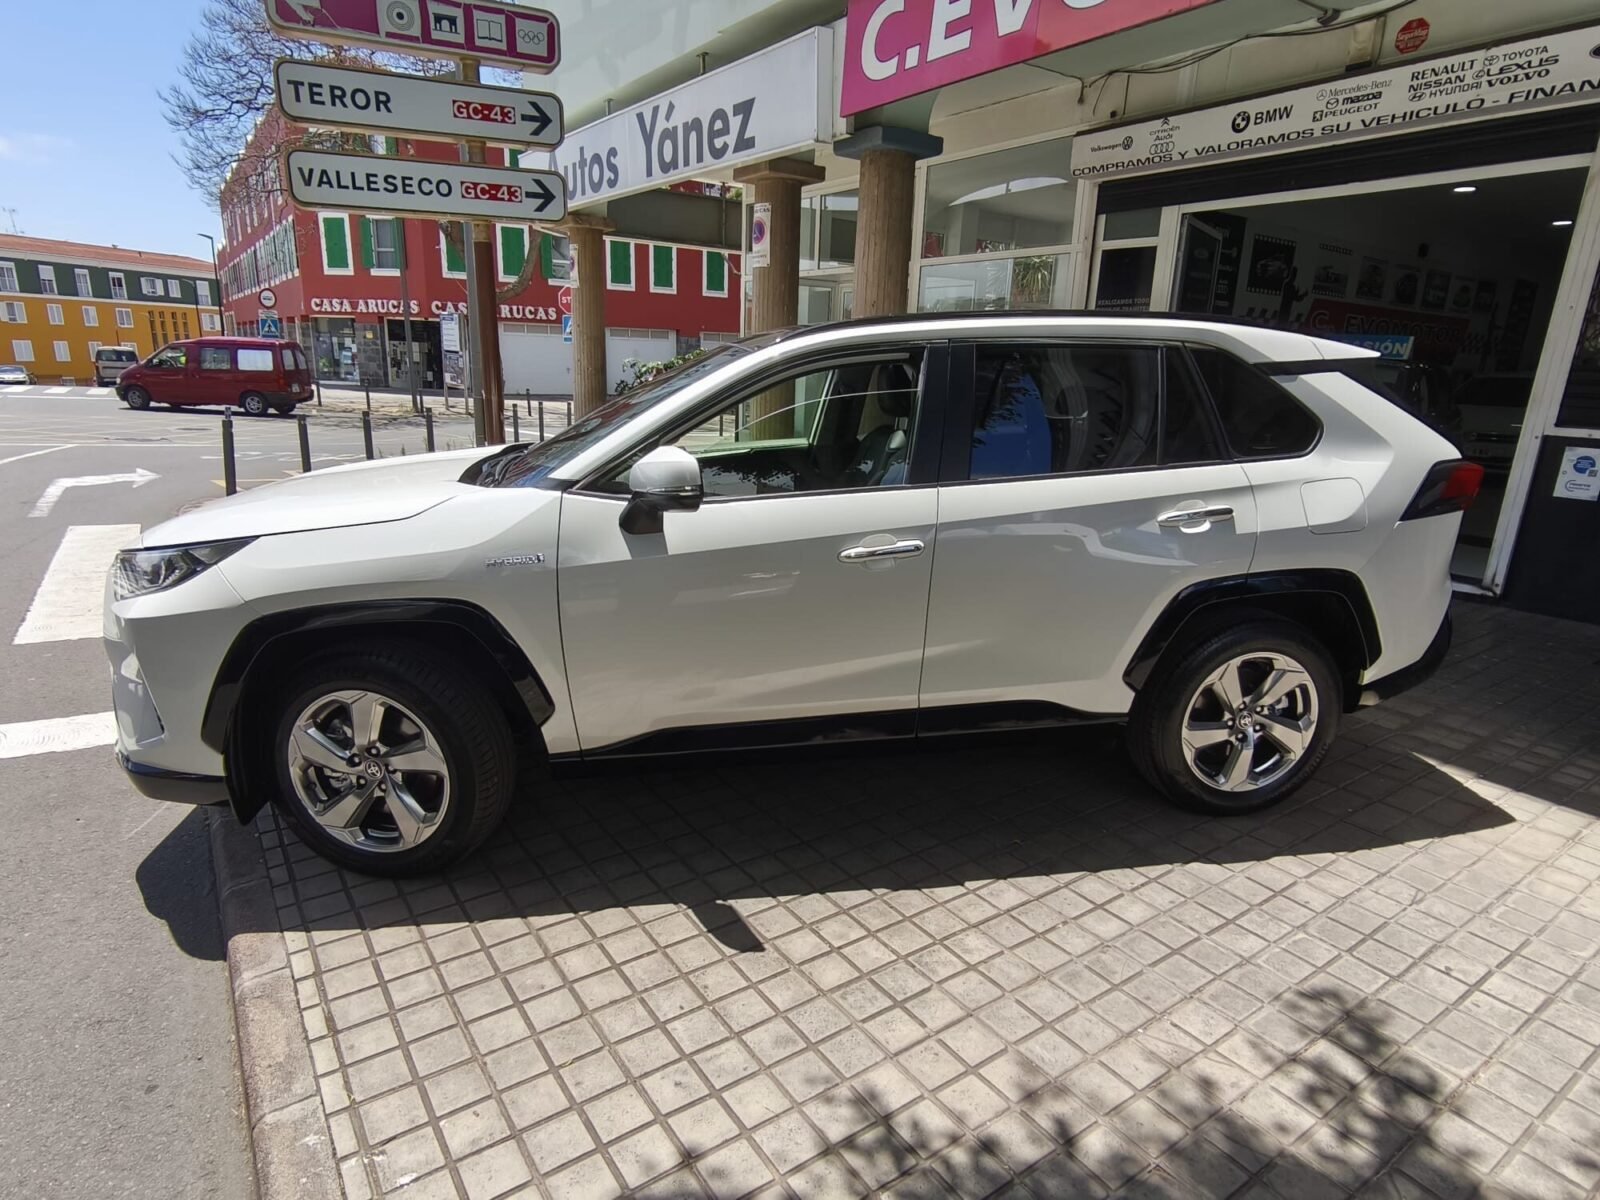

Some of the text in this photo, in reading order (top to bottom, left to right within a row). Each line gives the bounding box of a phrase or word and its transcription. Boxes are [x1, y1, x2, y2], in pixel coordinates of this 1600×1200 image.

[861, 0, 1103, 81] C.EV
[1502, 45, 1549, 62] TOYOTA
[1410, 59, 1478, 82] RENAULT
[1486, 54, 1560, 78] LEXUS
[1328, 78, 1393, 98] Mercedes-Benz
[1408, 74, 1466, 93] NISSAN
[1486, 68, 1550, 88] VOLVO
[1342, 91, 1383, 106] mazda
[1429, 80, 1482, 99] HYUNDAI
[287, 79, 516, 124] TEROR GC-43
[1324, 101, 1380, 119] PEUGEOT
[1253, 104, 1294, 126] BMW
[635, 96, 757, 178] Yánez
[1072, 153, 1173, 177] COMPRAMOS
[1178, 151, 1189, 160] Y
[1194, 128, 1315, 157] VALORAMOS
[1320, 122, 1351, 136] SU
[1360, 97, 1486, 128] VEHICULO
[1090, 142, 1122, 153] Volkswagen
[1154, 133, 1173, 142] Audi
[297, 166, 523, 203] VALLESECO GC-43
[311, 298, 351, 313] CASA
[431, 301, 468, 315] CAS
[497, 304, 557, 320] RUCAS
